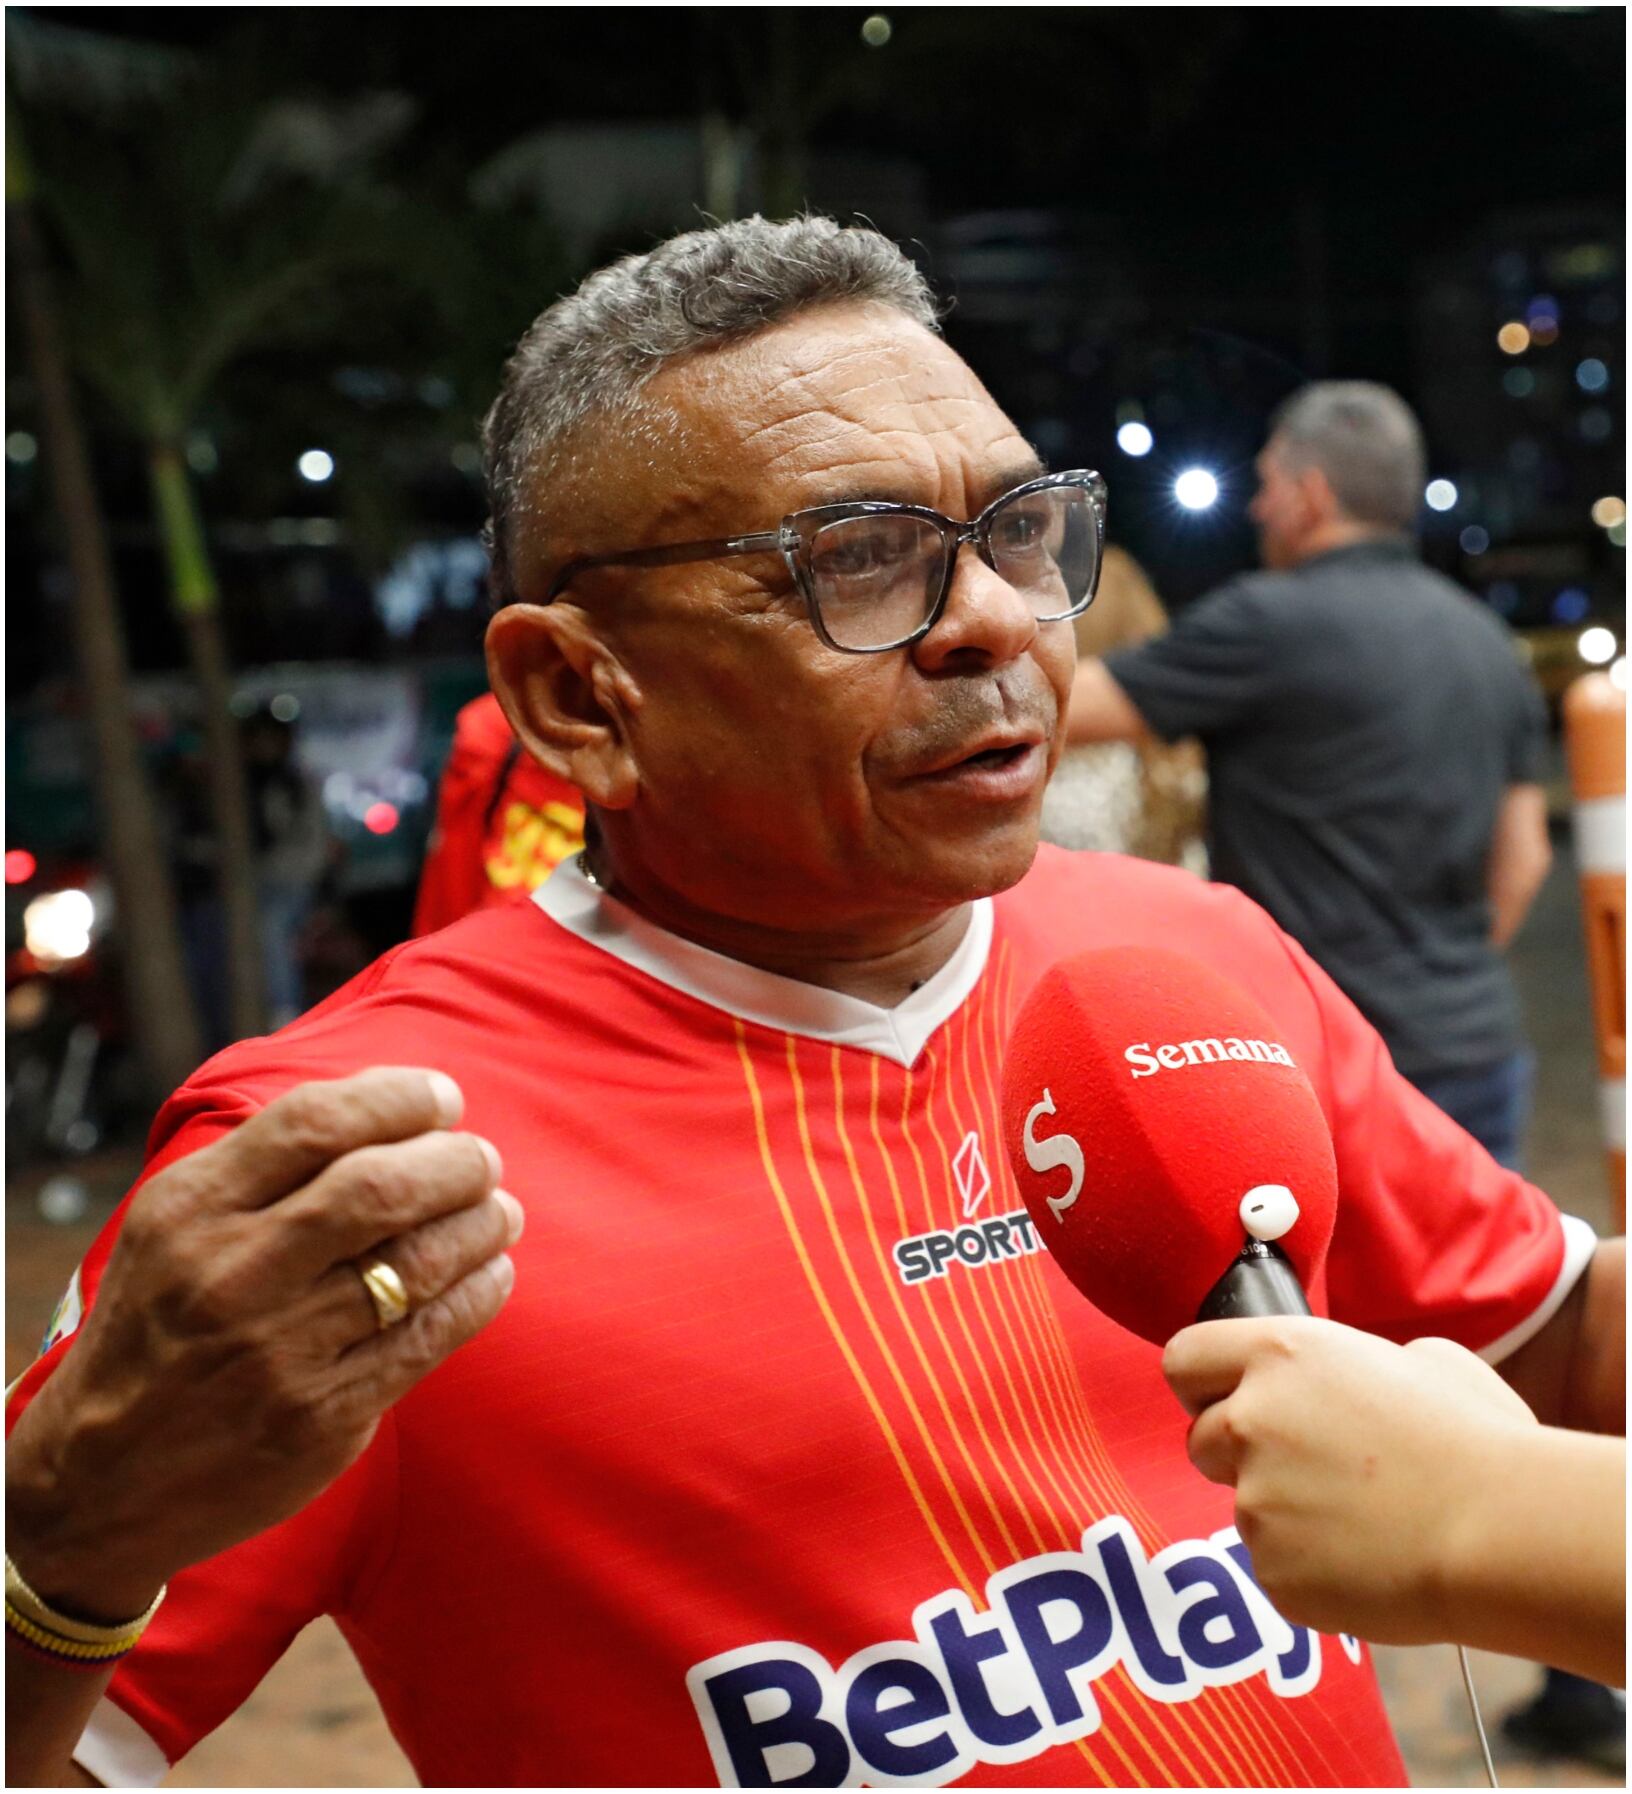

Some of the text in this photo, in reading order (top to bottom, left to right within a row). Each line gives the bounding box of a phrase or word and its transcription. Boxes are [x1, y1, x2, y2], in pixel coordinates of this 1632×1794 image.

[1124, 1037, 1296, 1079] Semana
[1023, 1087, 1085, 1224] S
[894, 1210, 1043, 1283] SPORT
